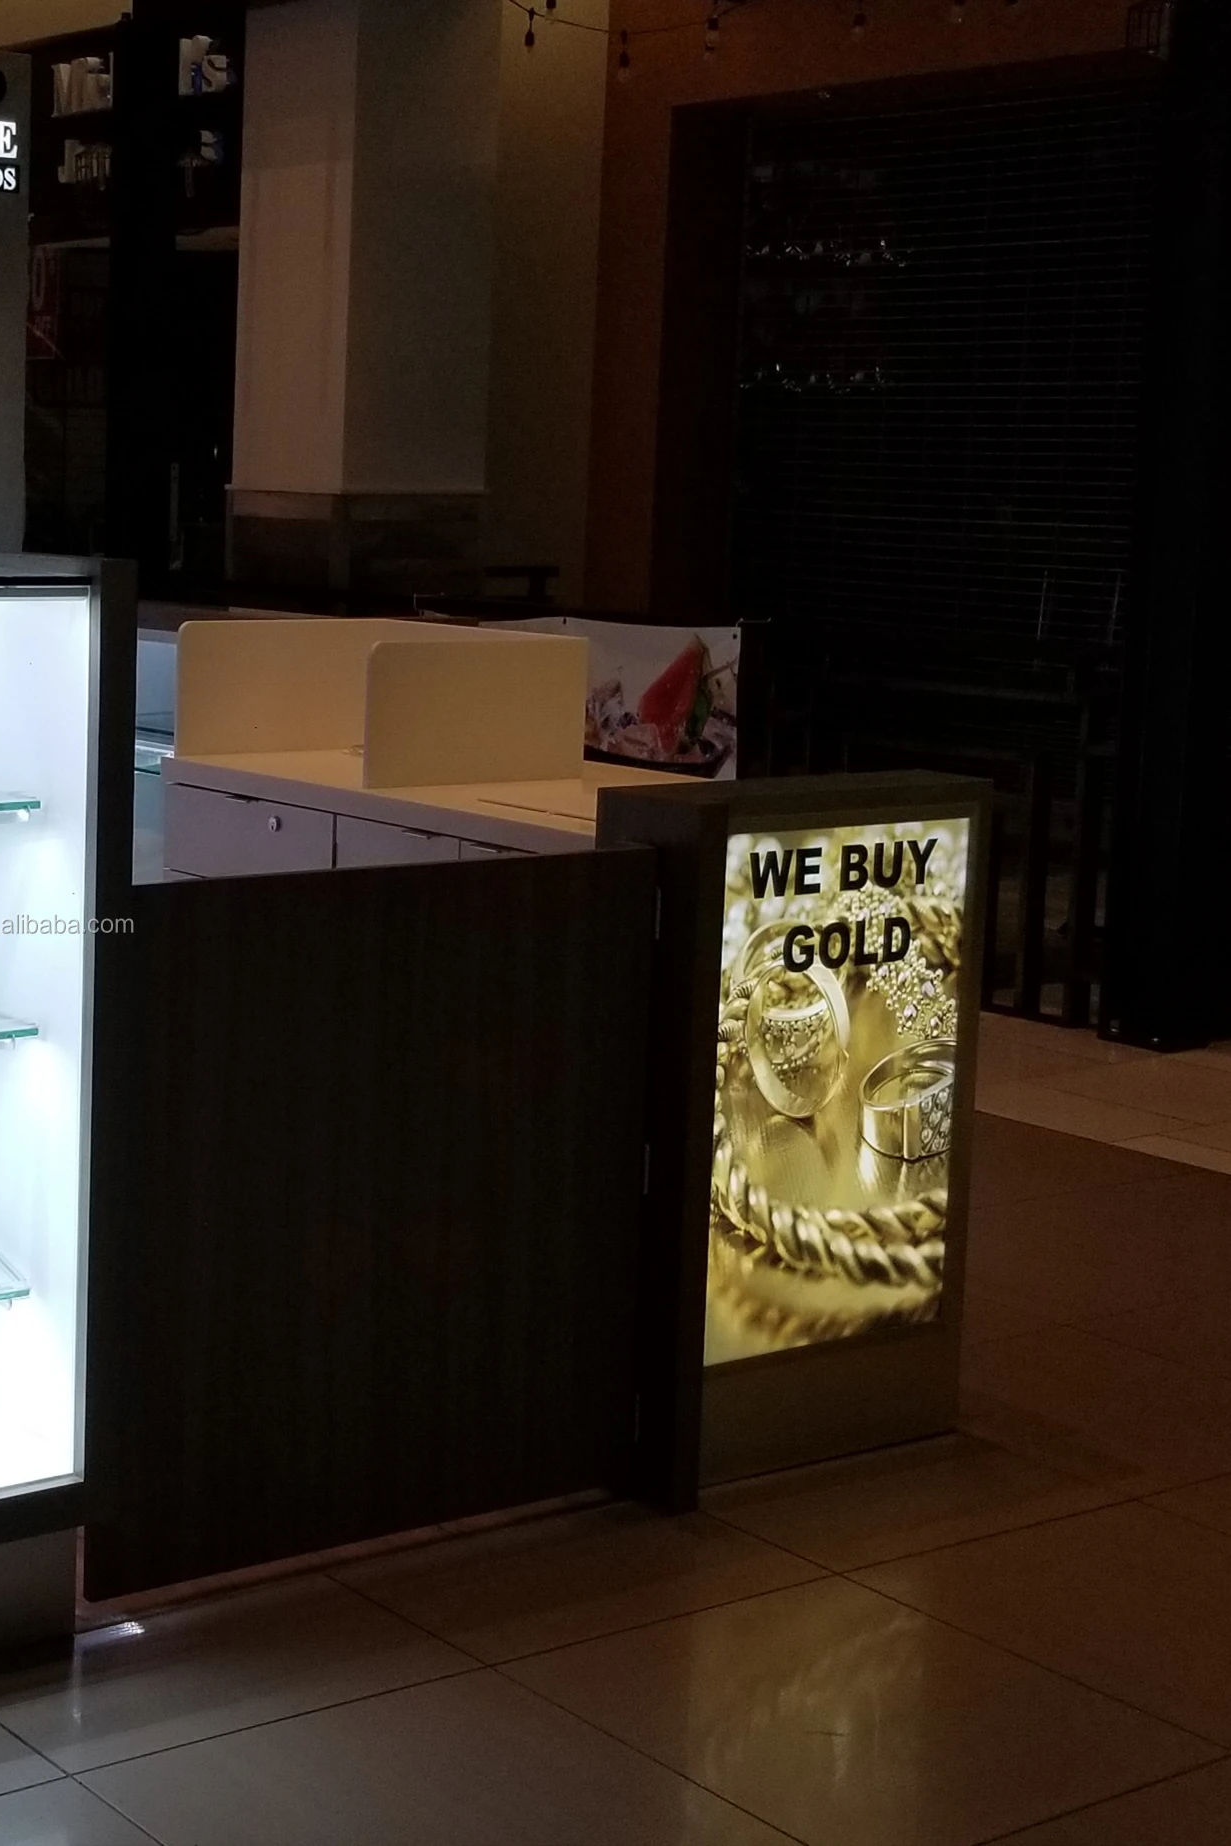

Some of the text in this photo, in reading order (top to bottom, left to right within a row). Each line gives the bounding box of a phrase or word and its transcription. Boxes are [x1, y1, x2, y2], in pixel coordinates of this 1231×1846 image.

[749, 838, 939, 899] WE BUY
[782, 916, 912, 973] GOLD
